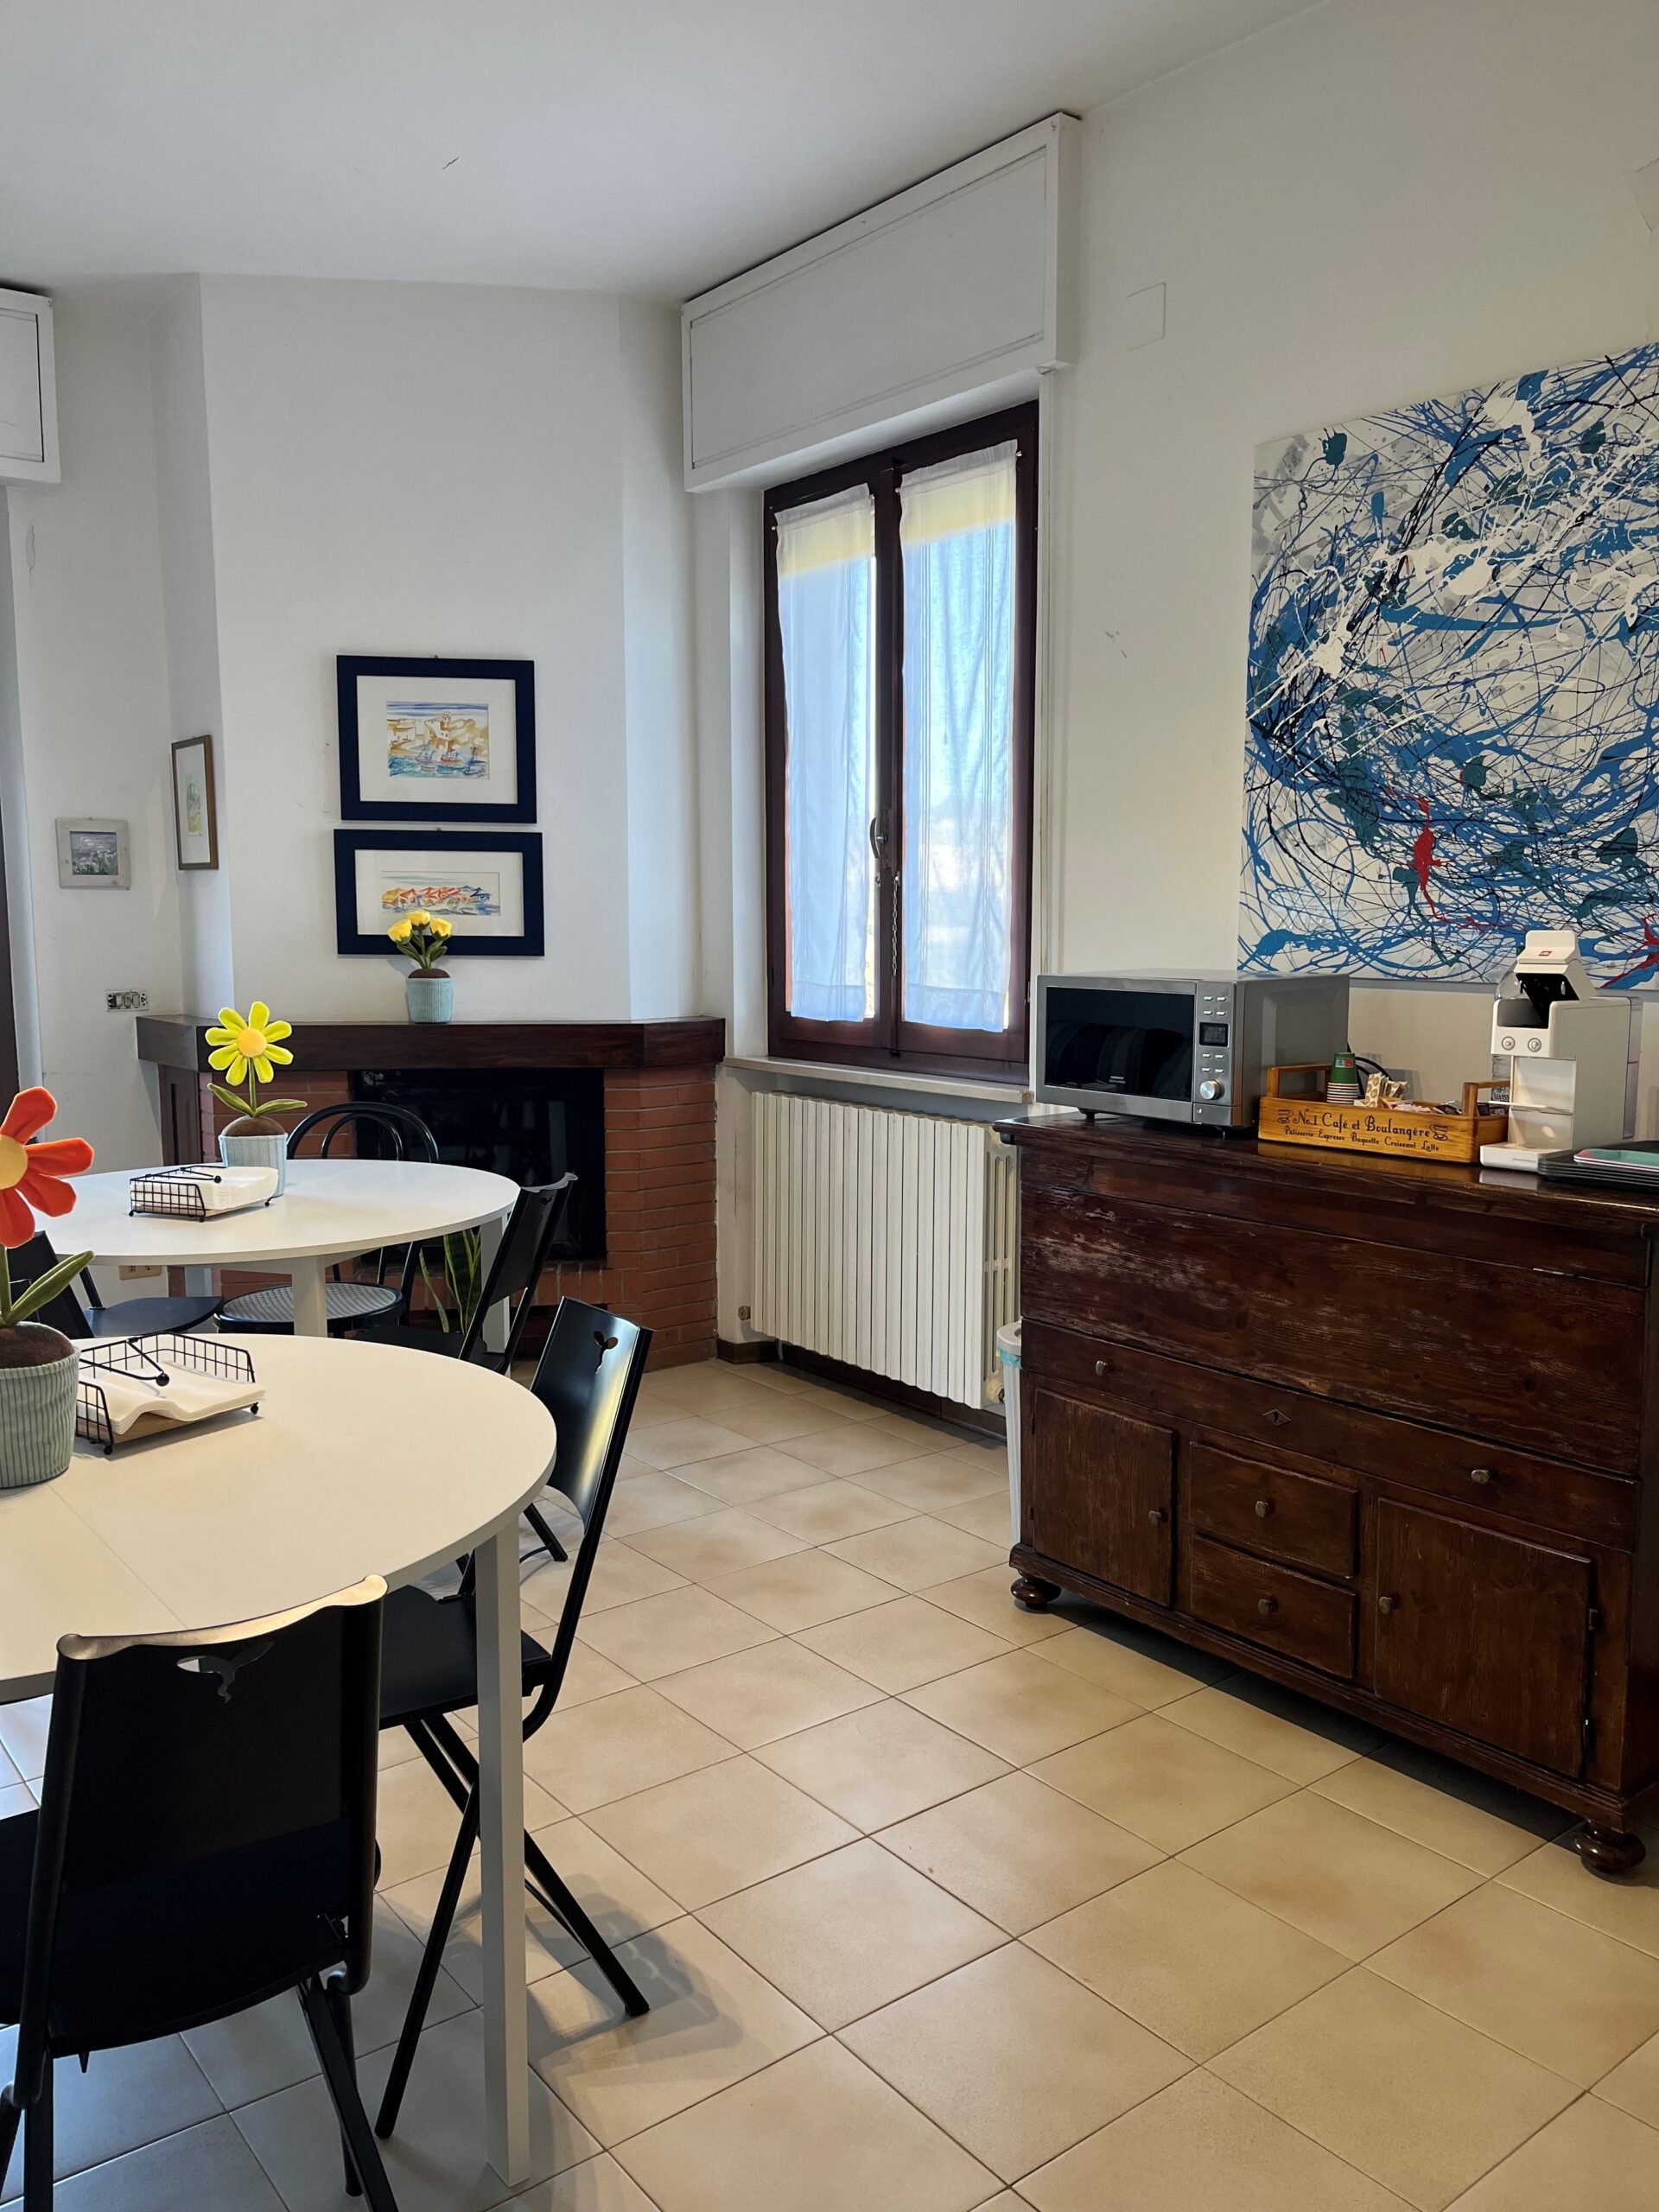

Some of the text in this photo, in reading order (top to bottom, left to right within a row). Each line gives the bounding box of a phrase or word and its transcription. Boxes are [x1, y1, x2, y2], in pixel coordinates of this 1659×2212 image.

[1321, 1112, 1348, 1134] Café
[1351, 1120, 1360, 1130] et
[1350, 1132, 1380, 1146] Baguette
[1384, 1136, 1416, 1148] Croissant
[1421, 1140, 1440, 1152] Latte
